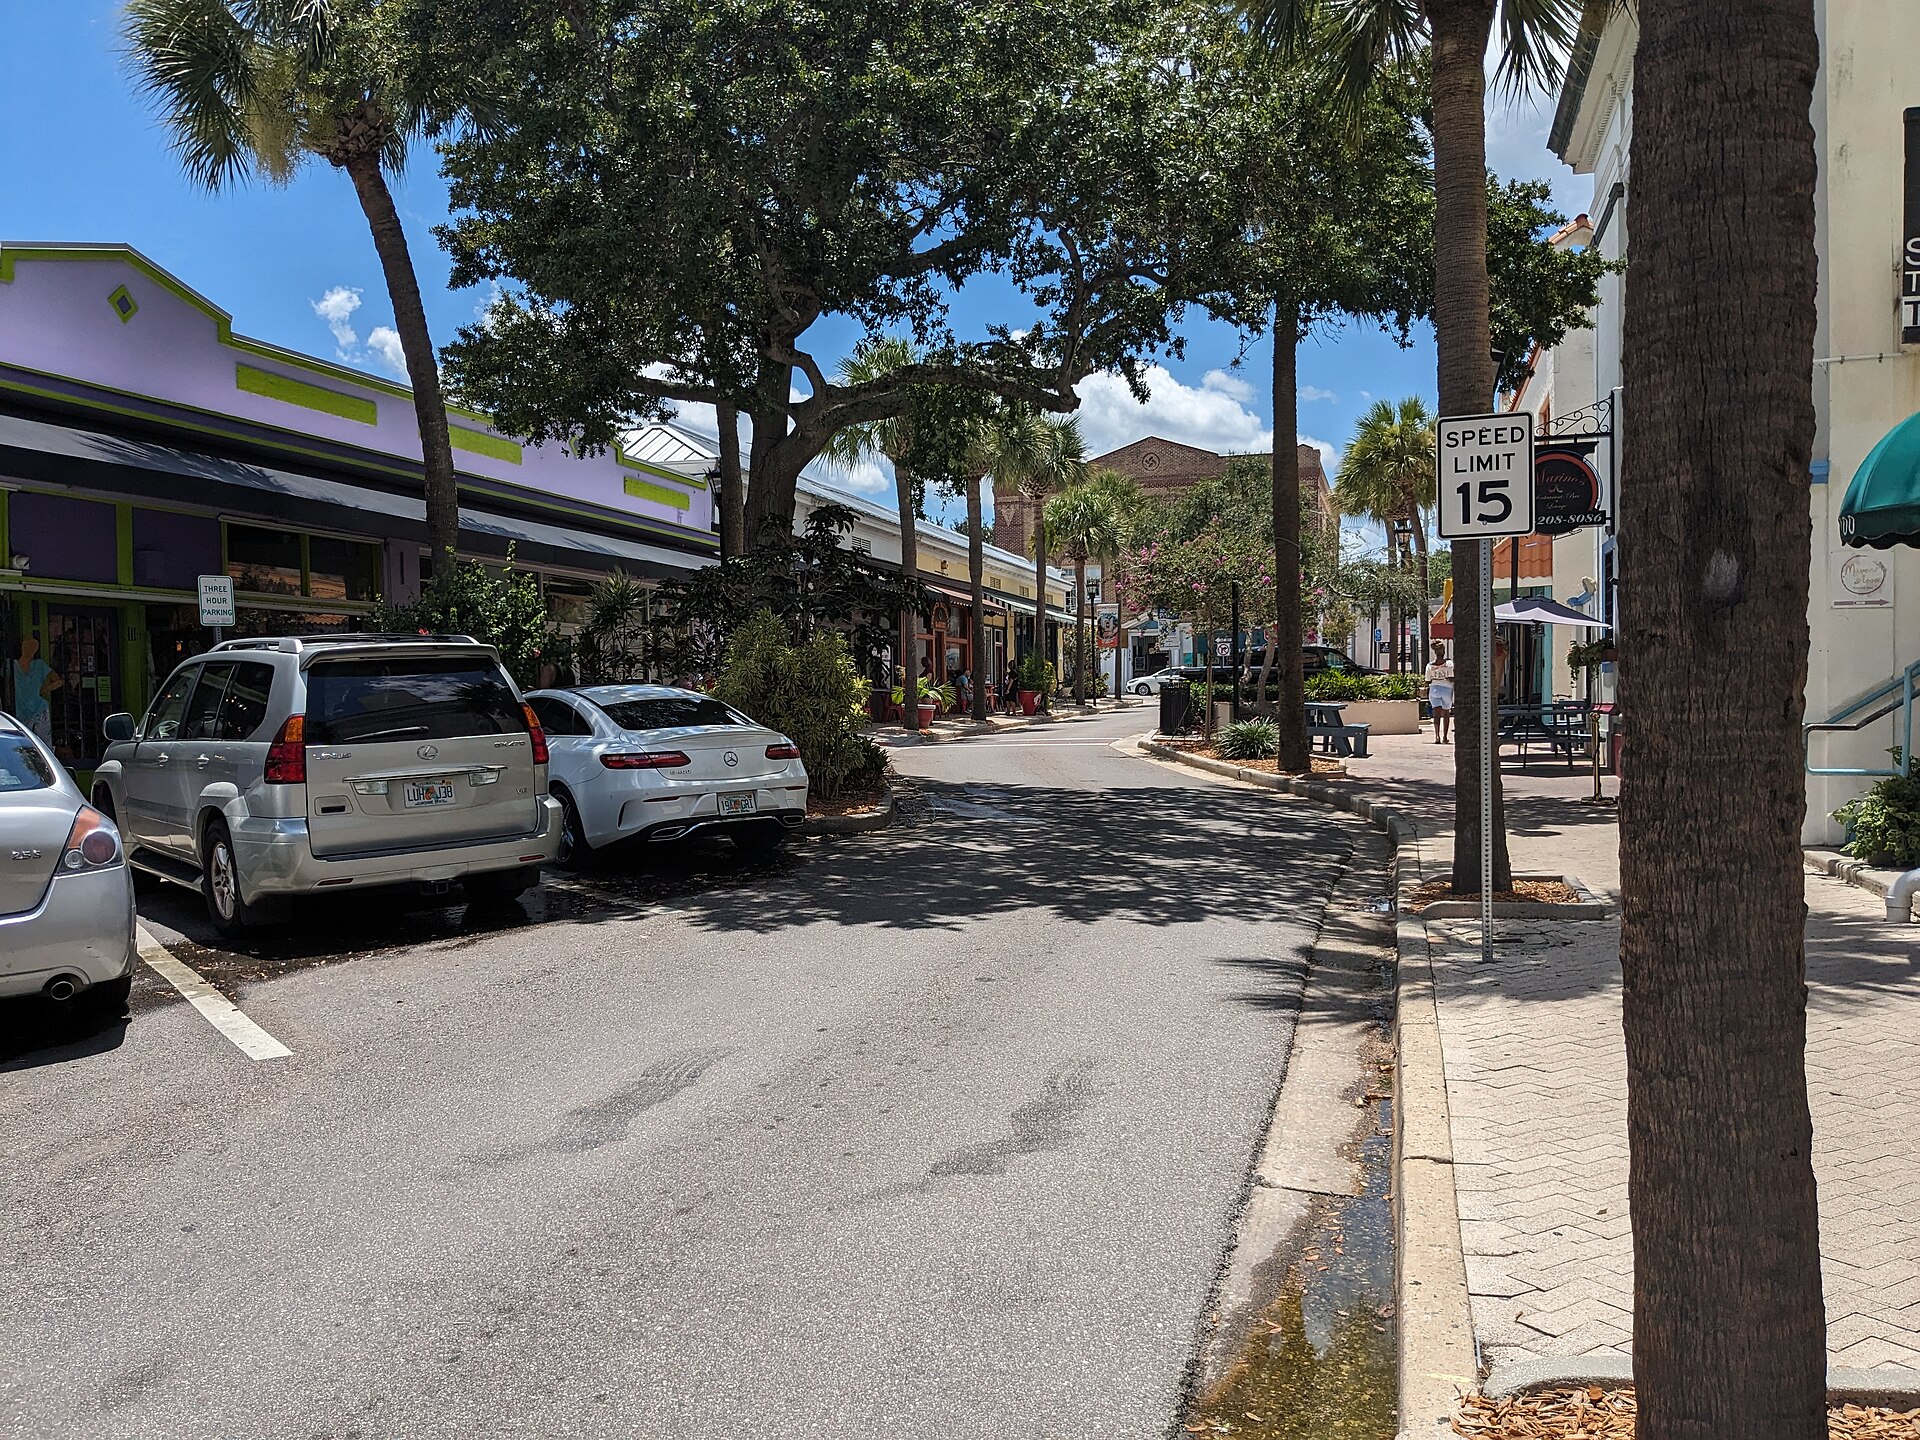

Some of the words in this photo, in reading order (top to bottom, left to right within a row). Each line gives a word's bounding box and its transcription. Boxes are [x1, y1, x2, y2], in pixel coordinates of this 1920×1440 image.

[1445, 426, 1525, 448] SPEED
[1454, 452, 1516, 474] LIMIT
[1456, 479, 1513, 525] 15
[204, 585, 228, 593] THREE
[206, 597, 227, 605] HOUR
[202, 608, 233, 616] PARKING
